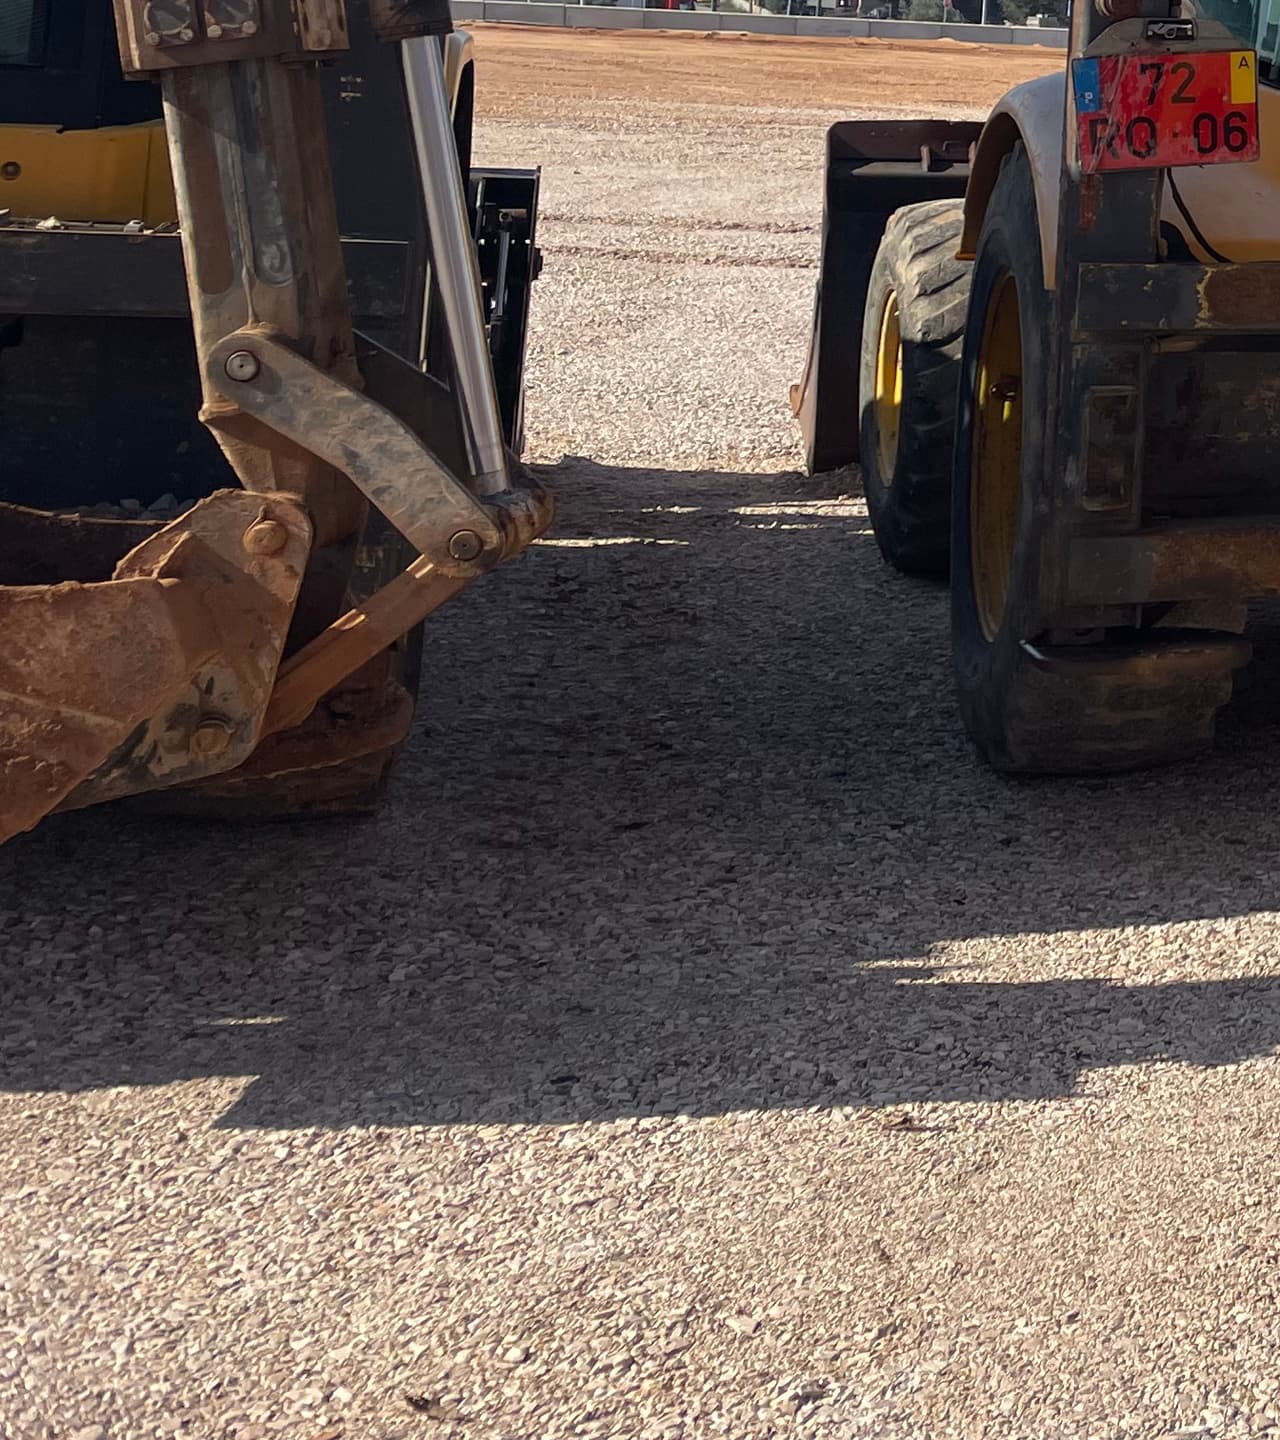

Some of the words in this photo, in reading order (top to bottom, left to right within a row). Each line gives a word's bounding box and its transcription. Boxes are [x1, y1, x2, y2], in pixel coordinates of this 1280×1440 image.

[1140, 61, 1197, 106] 72
[1237, 55, 1250, 70] A
[1192, 110, 1249, 155] 06
